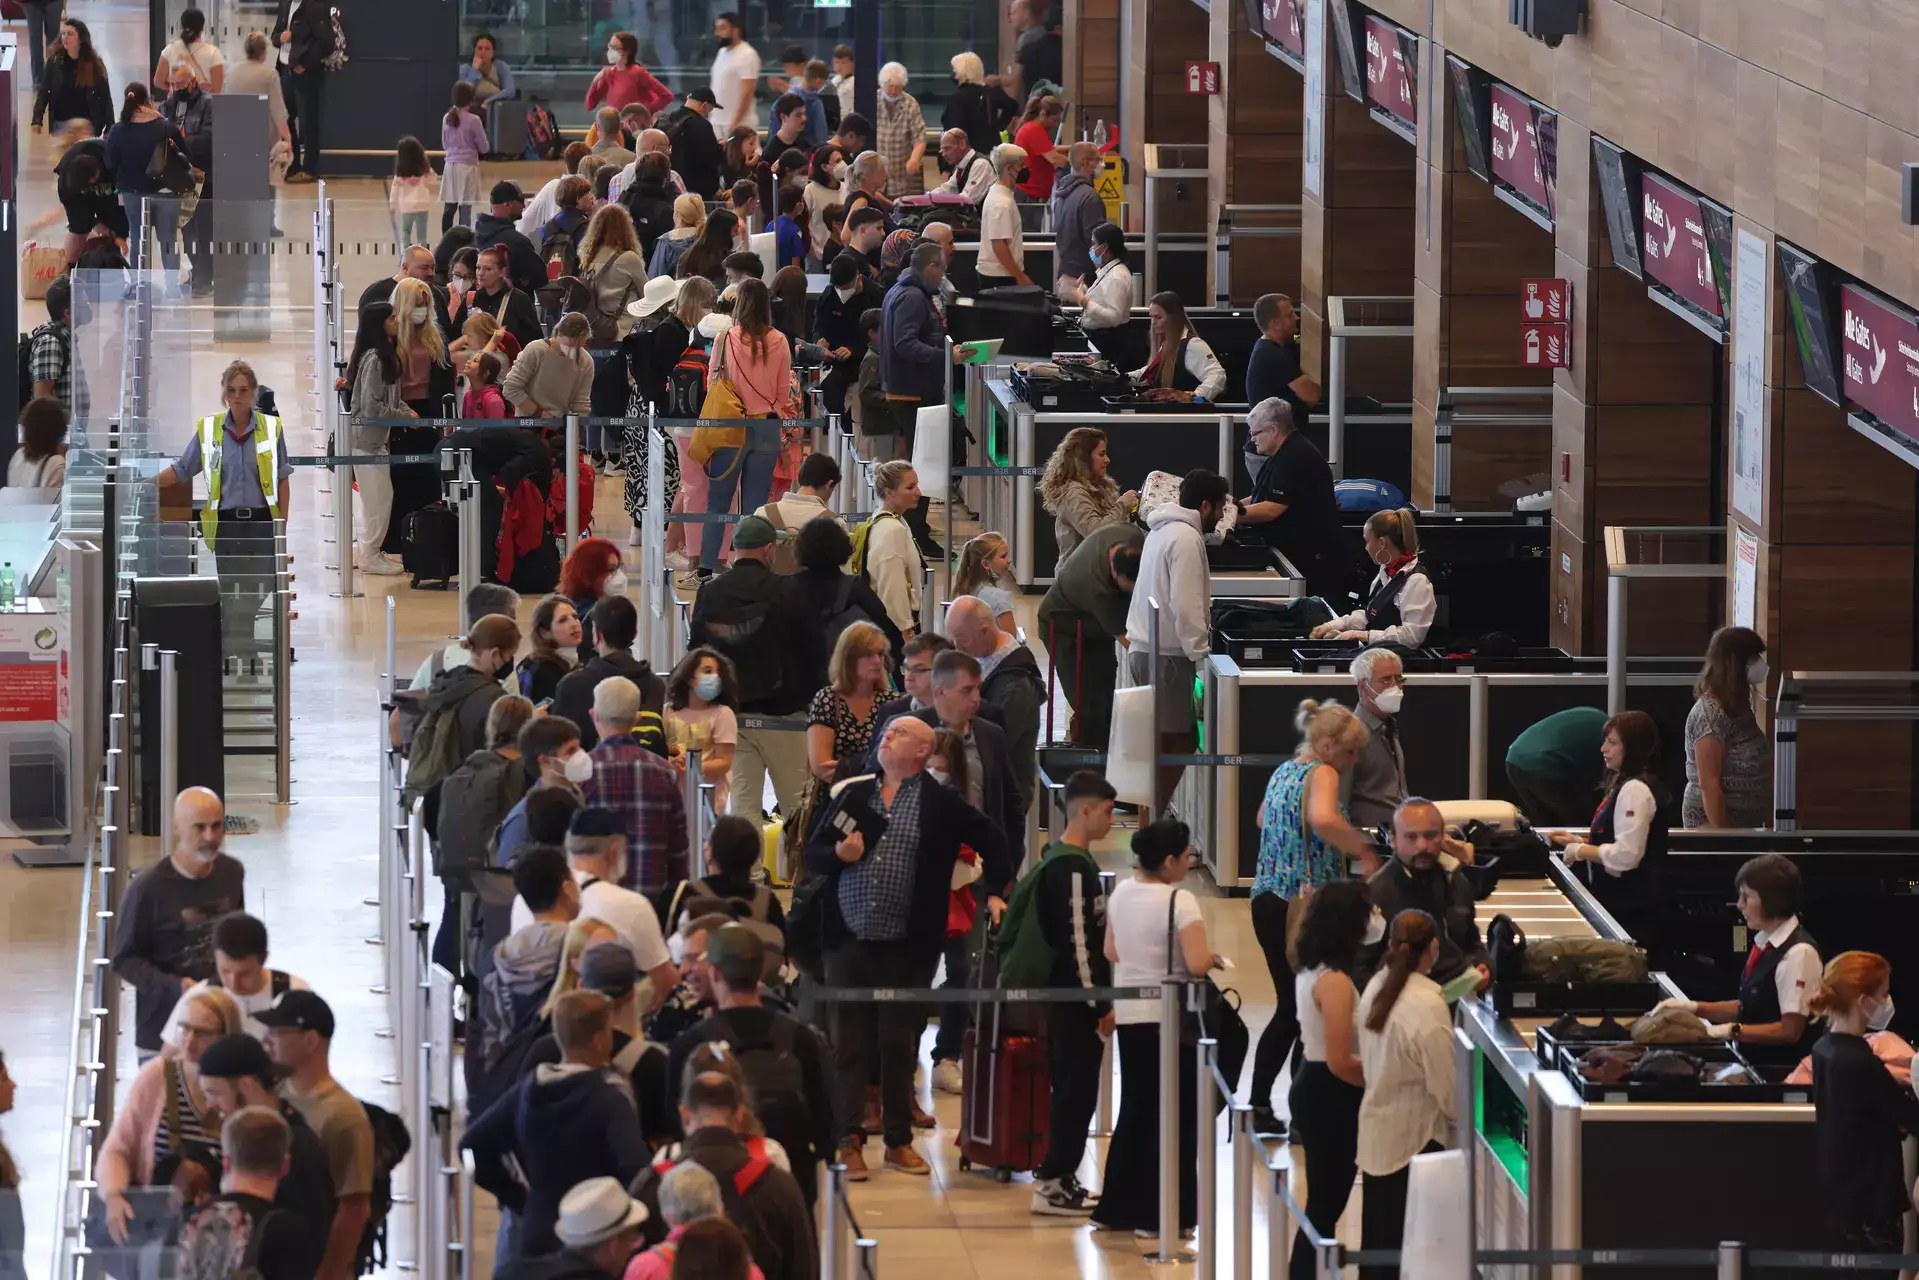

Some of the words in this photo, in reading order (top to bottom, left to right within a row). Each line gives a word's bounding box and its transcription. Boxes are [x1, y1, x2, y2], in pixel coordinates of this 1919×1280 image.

[1845, 309, 1855, 342] Alle
[1855, 316, 1870, 350] Gates
[315, 457, 330, 465] BER
[405, 455, 420, 463] BER
[745, 719, 763, 728] BER
[1224, 756, 1242, 765] BER
[873, 989, 895, 1000] BER
[1006, 989, 1028, 1000] BER
[1139, 987, 1161, 999] BER
[1592, 1251, 1617, 1263] BER
[1831, 1254, 1856, 1267] BER
